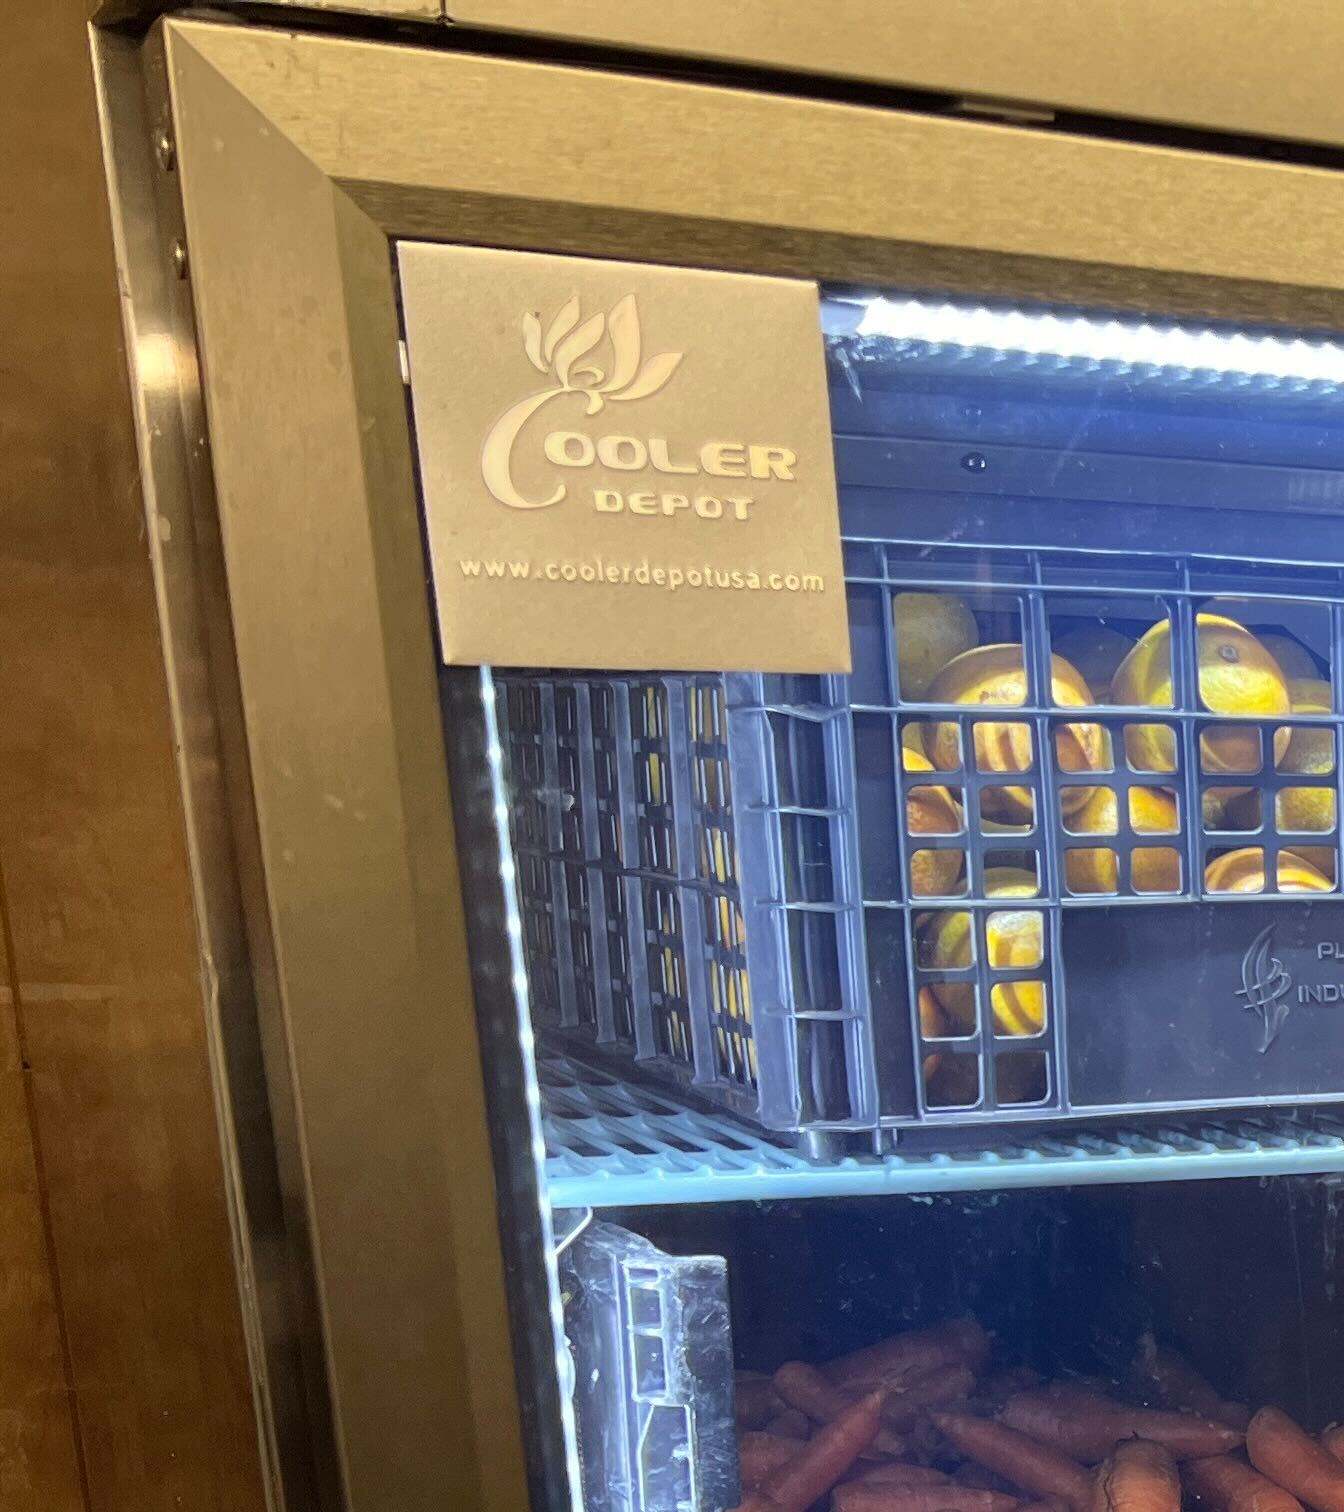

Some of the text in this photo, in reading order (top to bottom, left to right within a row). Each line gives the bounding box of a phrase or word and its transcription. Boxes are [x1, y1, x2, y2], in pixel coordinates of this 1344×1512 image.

[481, 385, 798, 510] COOLER
[593, 488, 756, 521] DEPOT
[459, 557, 826, 593] www.coolerdepotusa.com
